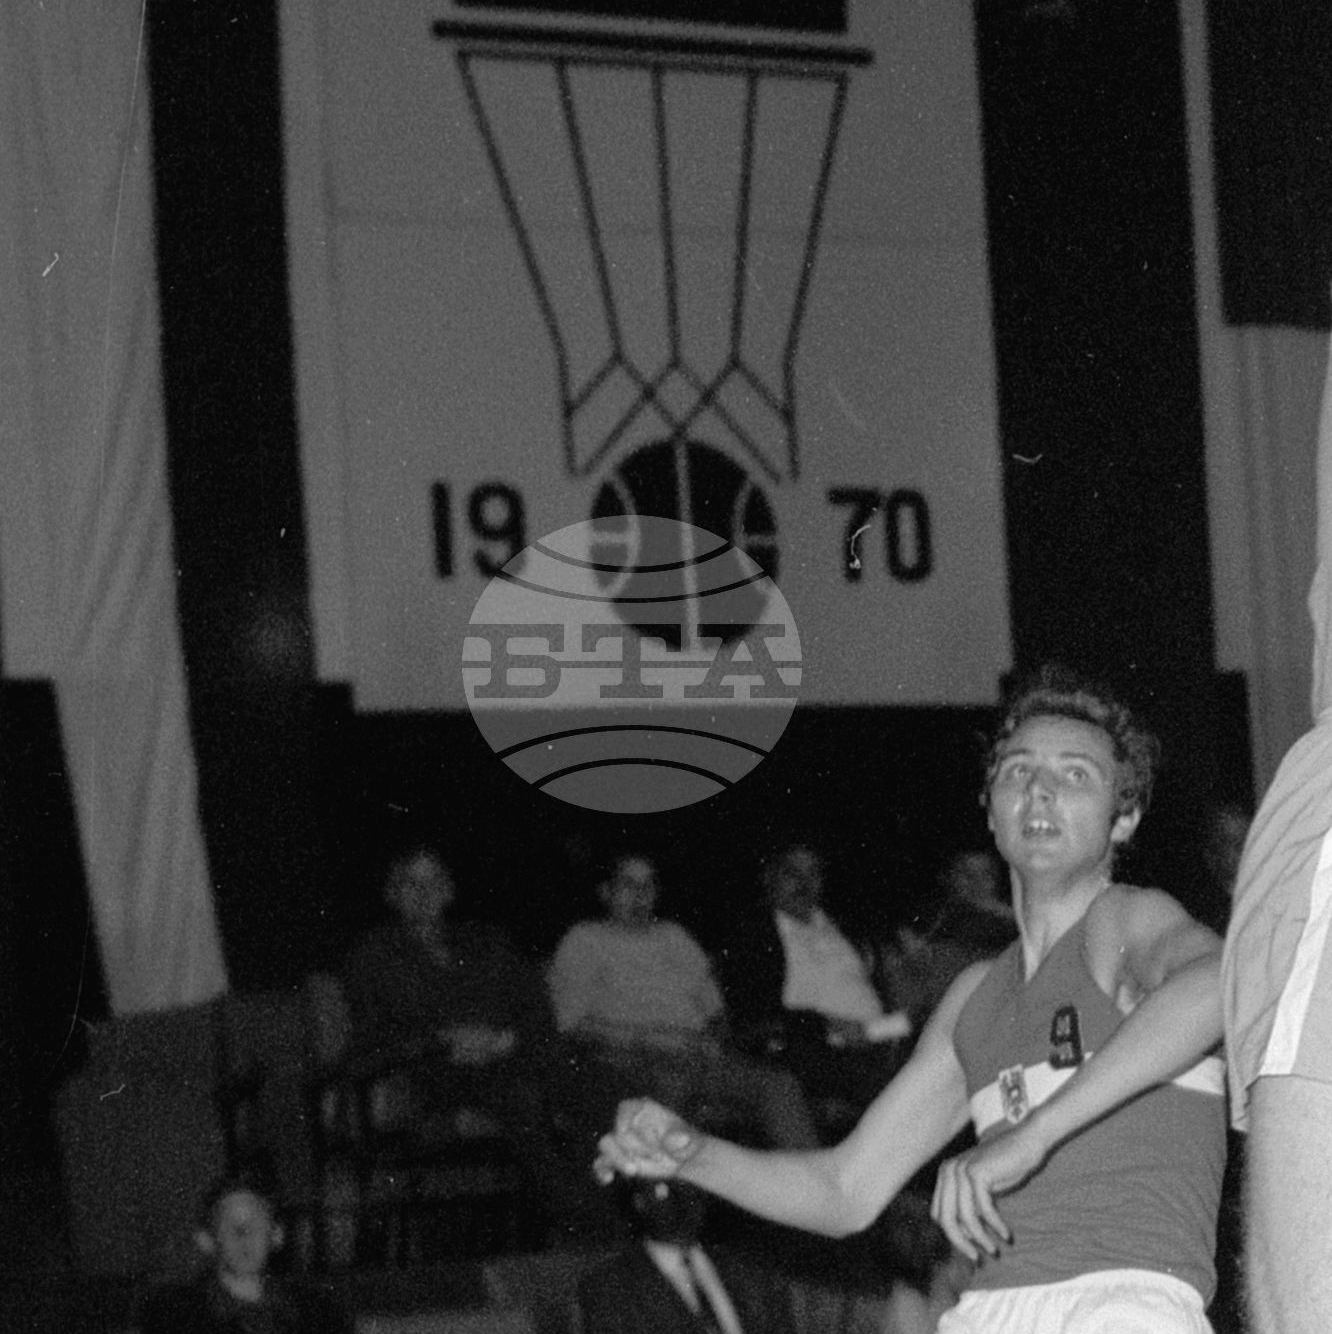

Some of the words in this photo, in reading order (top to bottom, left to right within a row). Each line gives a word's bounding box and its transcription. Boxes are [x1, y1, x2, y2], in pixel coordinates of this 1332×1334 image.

[431, 480, 527, 580] 19
[827, 486, 932, 583] 70
[1050, 1003, 1084, 1069] 9
